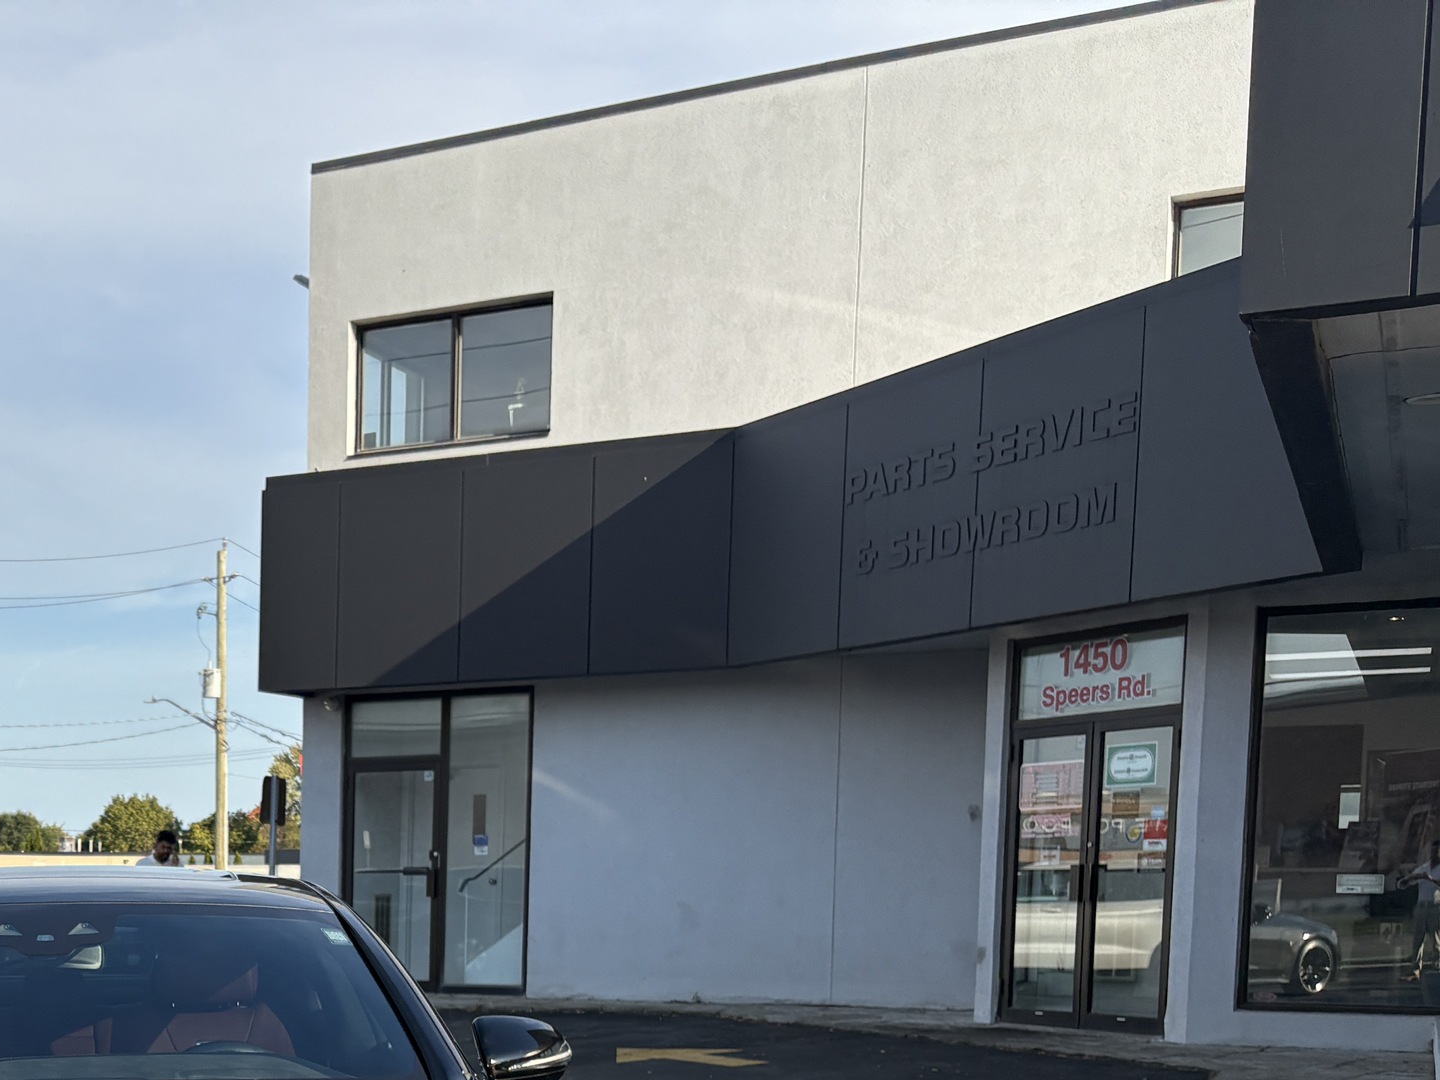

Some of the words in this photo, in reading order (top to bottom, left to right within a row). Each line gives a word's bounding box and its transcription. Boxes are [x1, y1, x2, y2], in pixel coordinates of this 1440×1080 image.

[847, 442, 956, 506] PARTS
[972, 391, 1137, 474] SERVICE
[858, 538, 879, 576] &
[889, 482, 1117, 570] SHOWROOM
[1060, 638, 1129, 678] 1450
[1042, 684, 1111, 712] Speers
[1117, 674, 1152, 699] Rd.
